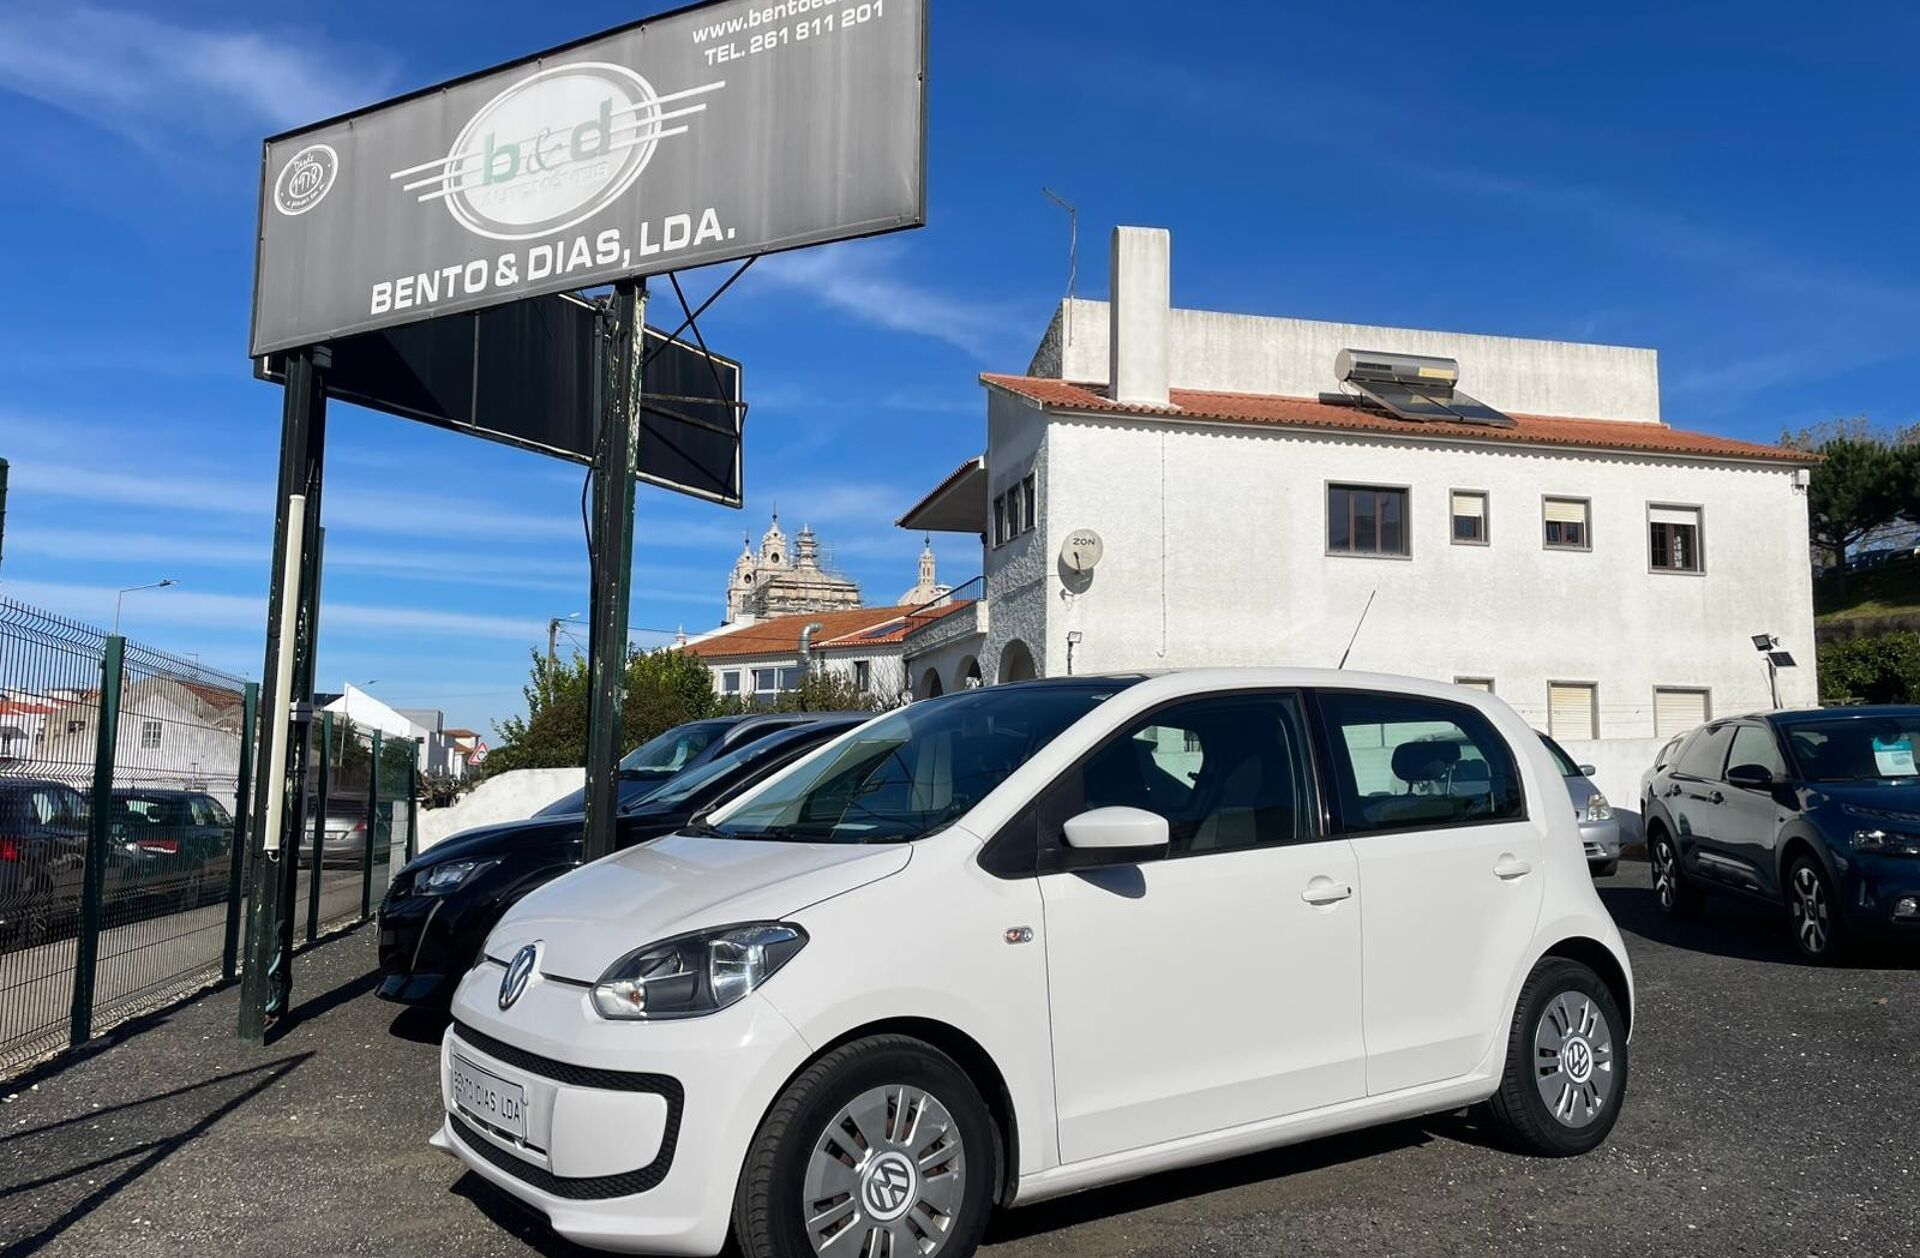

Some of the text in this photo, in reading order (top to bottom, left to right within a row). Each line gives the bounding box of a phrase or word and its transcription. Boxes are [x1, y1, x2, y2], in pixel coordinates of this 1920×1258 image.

[704, 0, 884, 66] TEL. 261 811 201
[370, 207, 736, 315] BENTO & DIAS, LDA.
[1072, 537, 1096, 546] ZON
[501, 1096, 520, 1121] LDA
